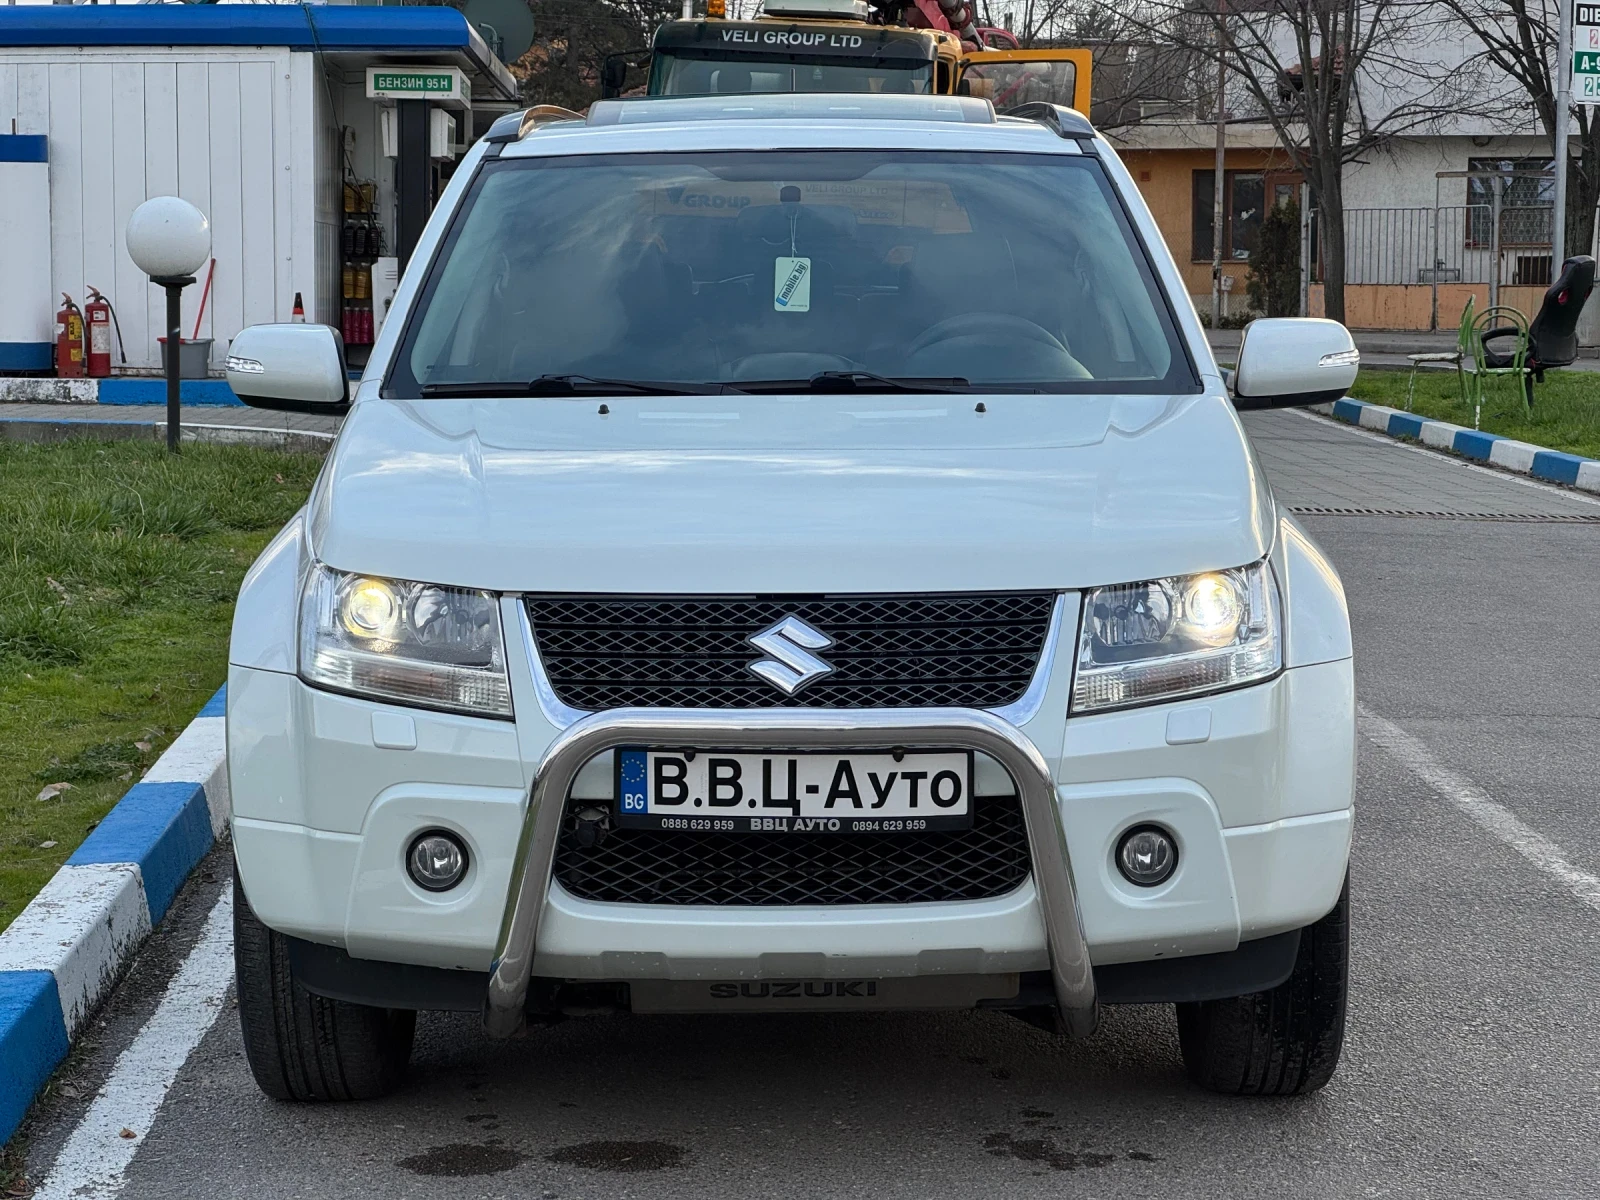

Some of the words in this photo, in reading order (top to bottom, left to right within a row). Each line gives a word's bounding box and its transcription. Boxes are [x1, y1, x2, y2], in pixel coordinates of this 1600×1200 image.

[721, 29, 759, 43] VELI
[763, 31, 826, 46] GROUP
[830, 34, 862, 48] LTD
[379, 77, 423, 88] БЕНЗИН
[426, 78, 439, 89] 95
[440, 78, 448, 89] Н
[781, 263, 807, 300] mobile.bg
[624, 793, 644, 809] BG
[661, 818, 688, 829] 0888
[690, 819, 711, 830] 629
[713, 819, 734, 830] 959
[750, 818, 788, 832] ВВЦ
[793, 818, 841, 831] АУТО
[852, 821, 880, 831] 0894
[882, 820, 903, 831] 629
[905, 820, 926, 830] 959
[709, 981, 877, 998] SUZUKI
